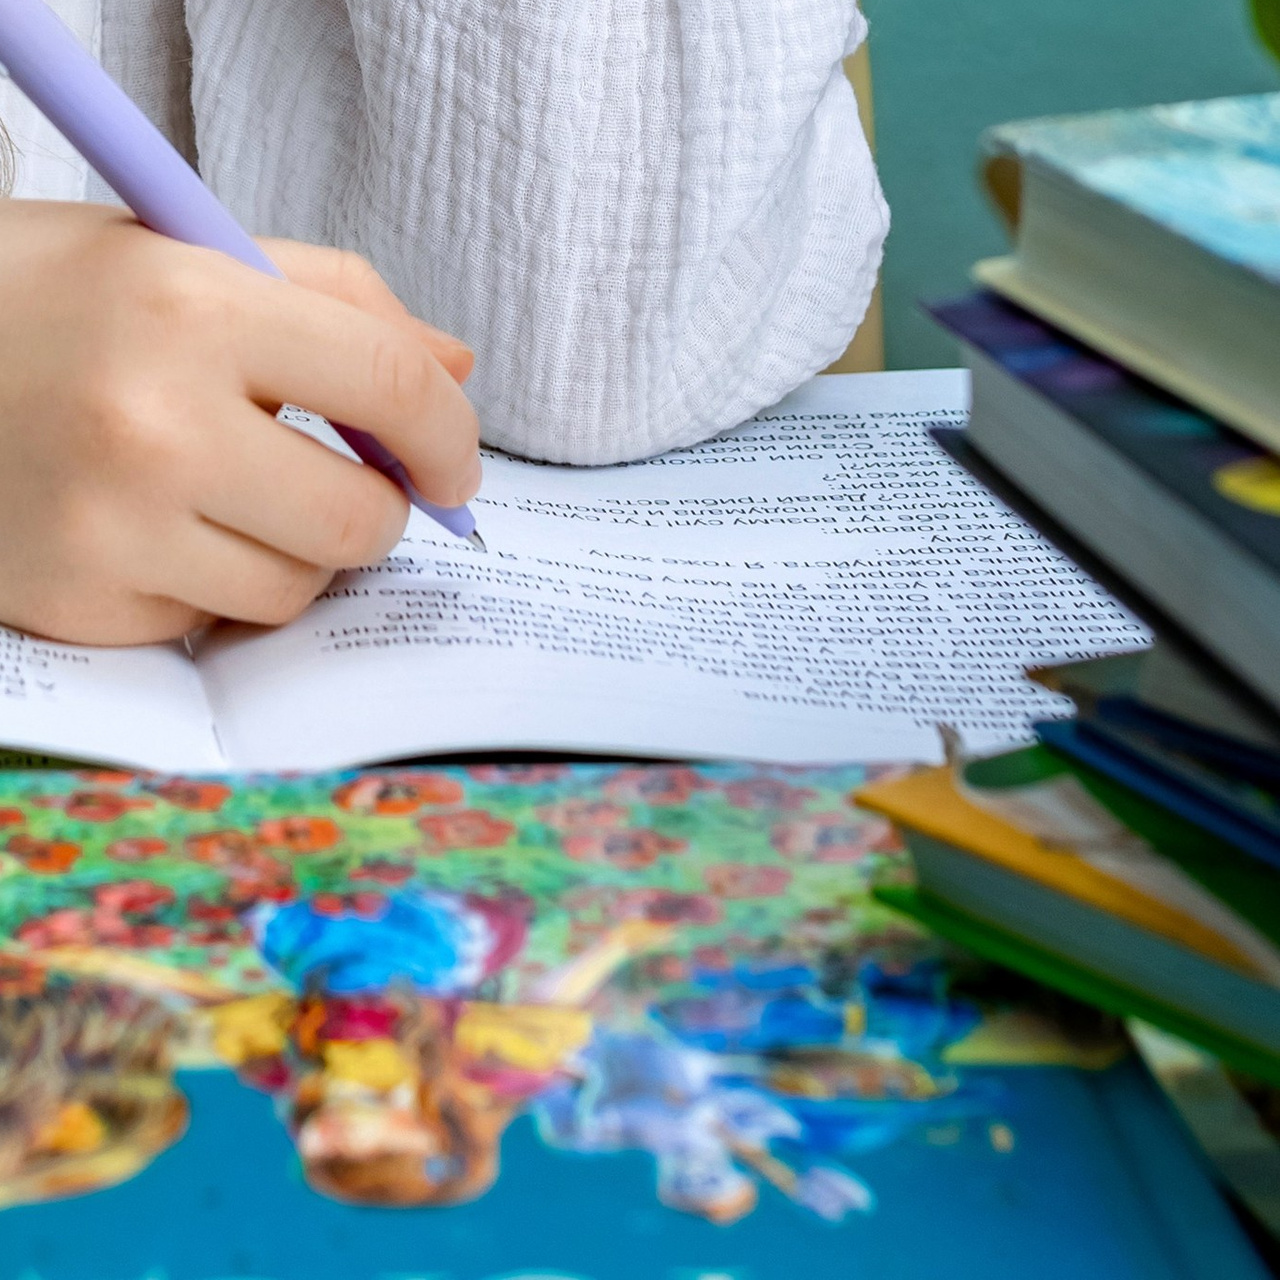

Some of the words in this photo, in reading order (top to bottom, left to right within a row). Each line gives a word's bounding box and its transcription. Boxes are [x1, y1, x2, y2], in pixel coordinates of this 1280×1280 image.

[751, 424, 827, 433] что...
[833, 422, 881, 432] где
[886, 420, 968, 432] мёшь,
[702, 434, 812, 446] переме
[821, 433, 871, 441] все
[878, 431, 927, 440] них
[785, 443, 874, 453] Стали
[834, 451, 947, 461] сыпали
[822, 472, 900, 483] есть?
[827, 481, 953, 492] говорит:
[678, 496, 769, 509] грибы
[777, 493, 868, 506] Давай
[877, 492, 940, 504] что?
[512, 497, 639, 517] говорит:
[825, 501, 995, 512] помолчала,
[516, 504, 601, 521] супов
[672, 507, 817, 517] подумала
[610, 518, 659, 527] Тут
[732, 517, 837, 525] возьму
[846, 515, 888, 524] тут
[897, 513, 967, 522] тебе
[665, 519, 725, 527] суп!
[820, 525, 948, 535] говорит:
[578, 548, 654, 562] хочу.
[874, 546, 1004, 555] говорит:
[661, 558, 737, 567] тоже
[772, 559, 962, 569] пожалуйста.
[969, 556, 1066, 564] хнычь,
[526, 556, 653, 581] больше.
[824, 568, 955, 578] говорит:
[435, 570, 542, 590] пошли
[661, 576, 733, 587] могу
[815, 581, 928, 589] устала.
[960, 578, 1096, 587] марочка,
[577, 583, 631, 598] них
[727, 590, 860, 601] говорит:
[869, 594, 930, 602] Она
[582, 591, 732, 618] корзинки
[664, 595, 817, 613] Корзинки
[955, 603, 1067, 611] теперь
[1072, 601, 1117, 609] им
[742, 612, 865, 623] полные
[1031, 613, 1126, 621] взяли
[827, 627, 938, 637] грибов
[946, 627, 1042, 635] много
[1049, 625, 1142, 633] очень
[689, 636, 749, 648] уже
[752, 633, 789, 642] не
[796, 636, 876, 647] даже
[939, 637, 1081, 647] набрали,
[755, 643, 810, 654] них
